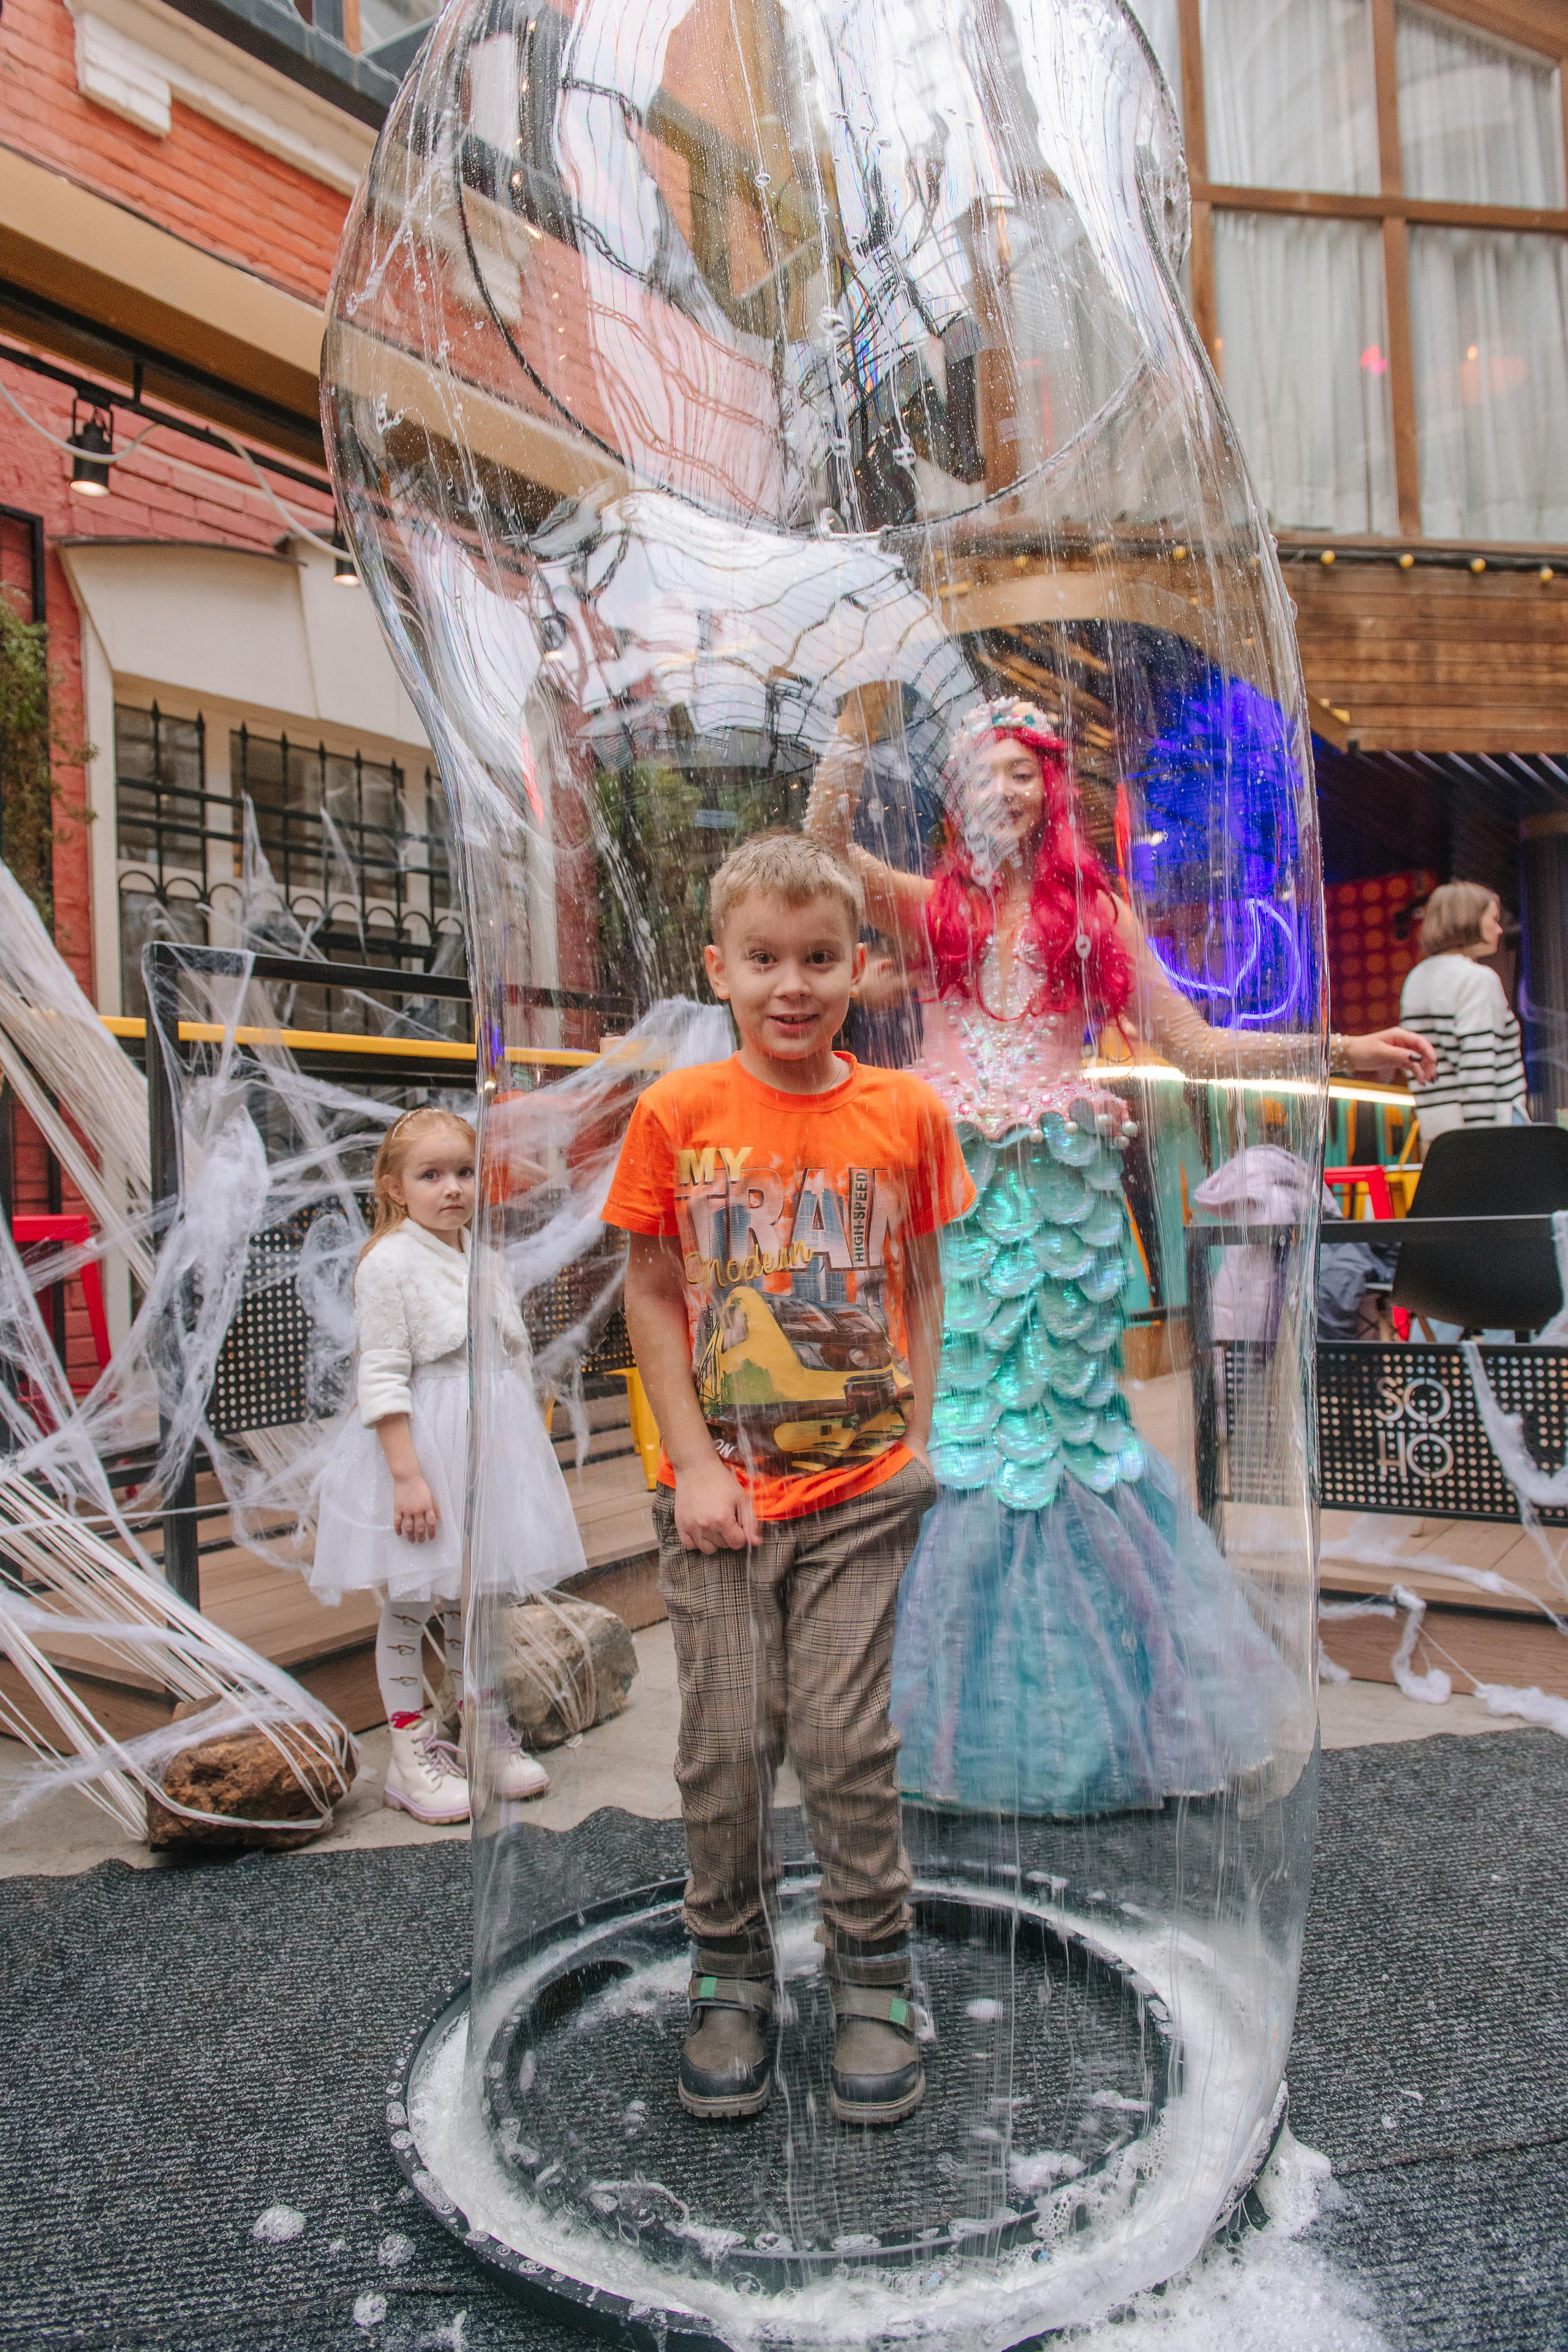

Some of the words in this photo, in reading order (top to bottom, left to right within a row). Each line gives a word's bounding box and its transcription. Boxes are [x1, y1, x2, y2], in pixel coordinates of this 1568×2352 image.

[679, 1146, 753, 1186] MY
[853, 1172, 869, 1262] HIGH-SPEED
[1373, 1376, 1452, 1424] SO
[1376, 1431, 1455, 1479] HO
